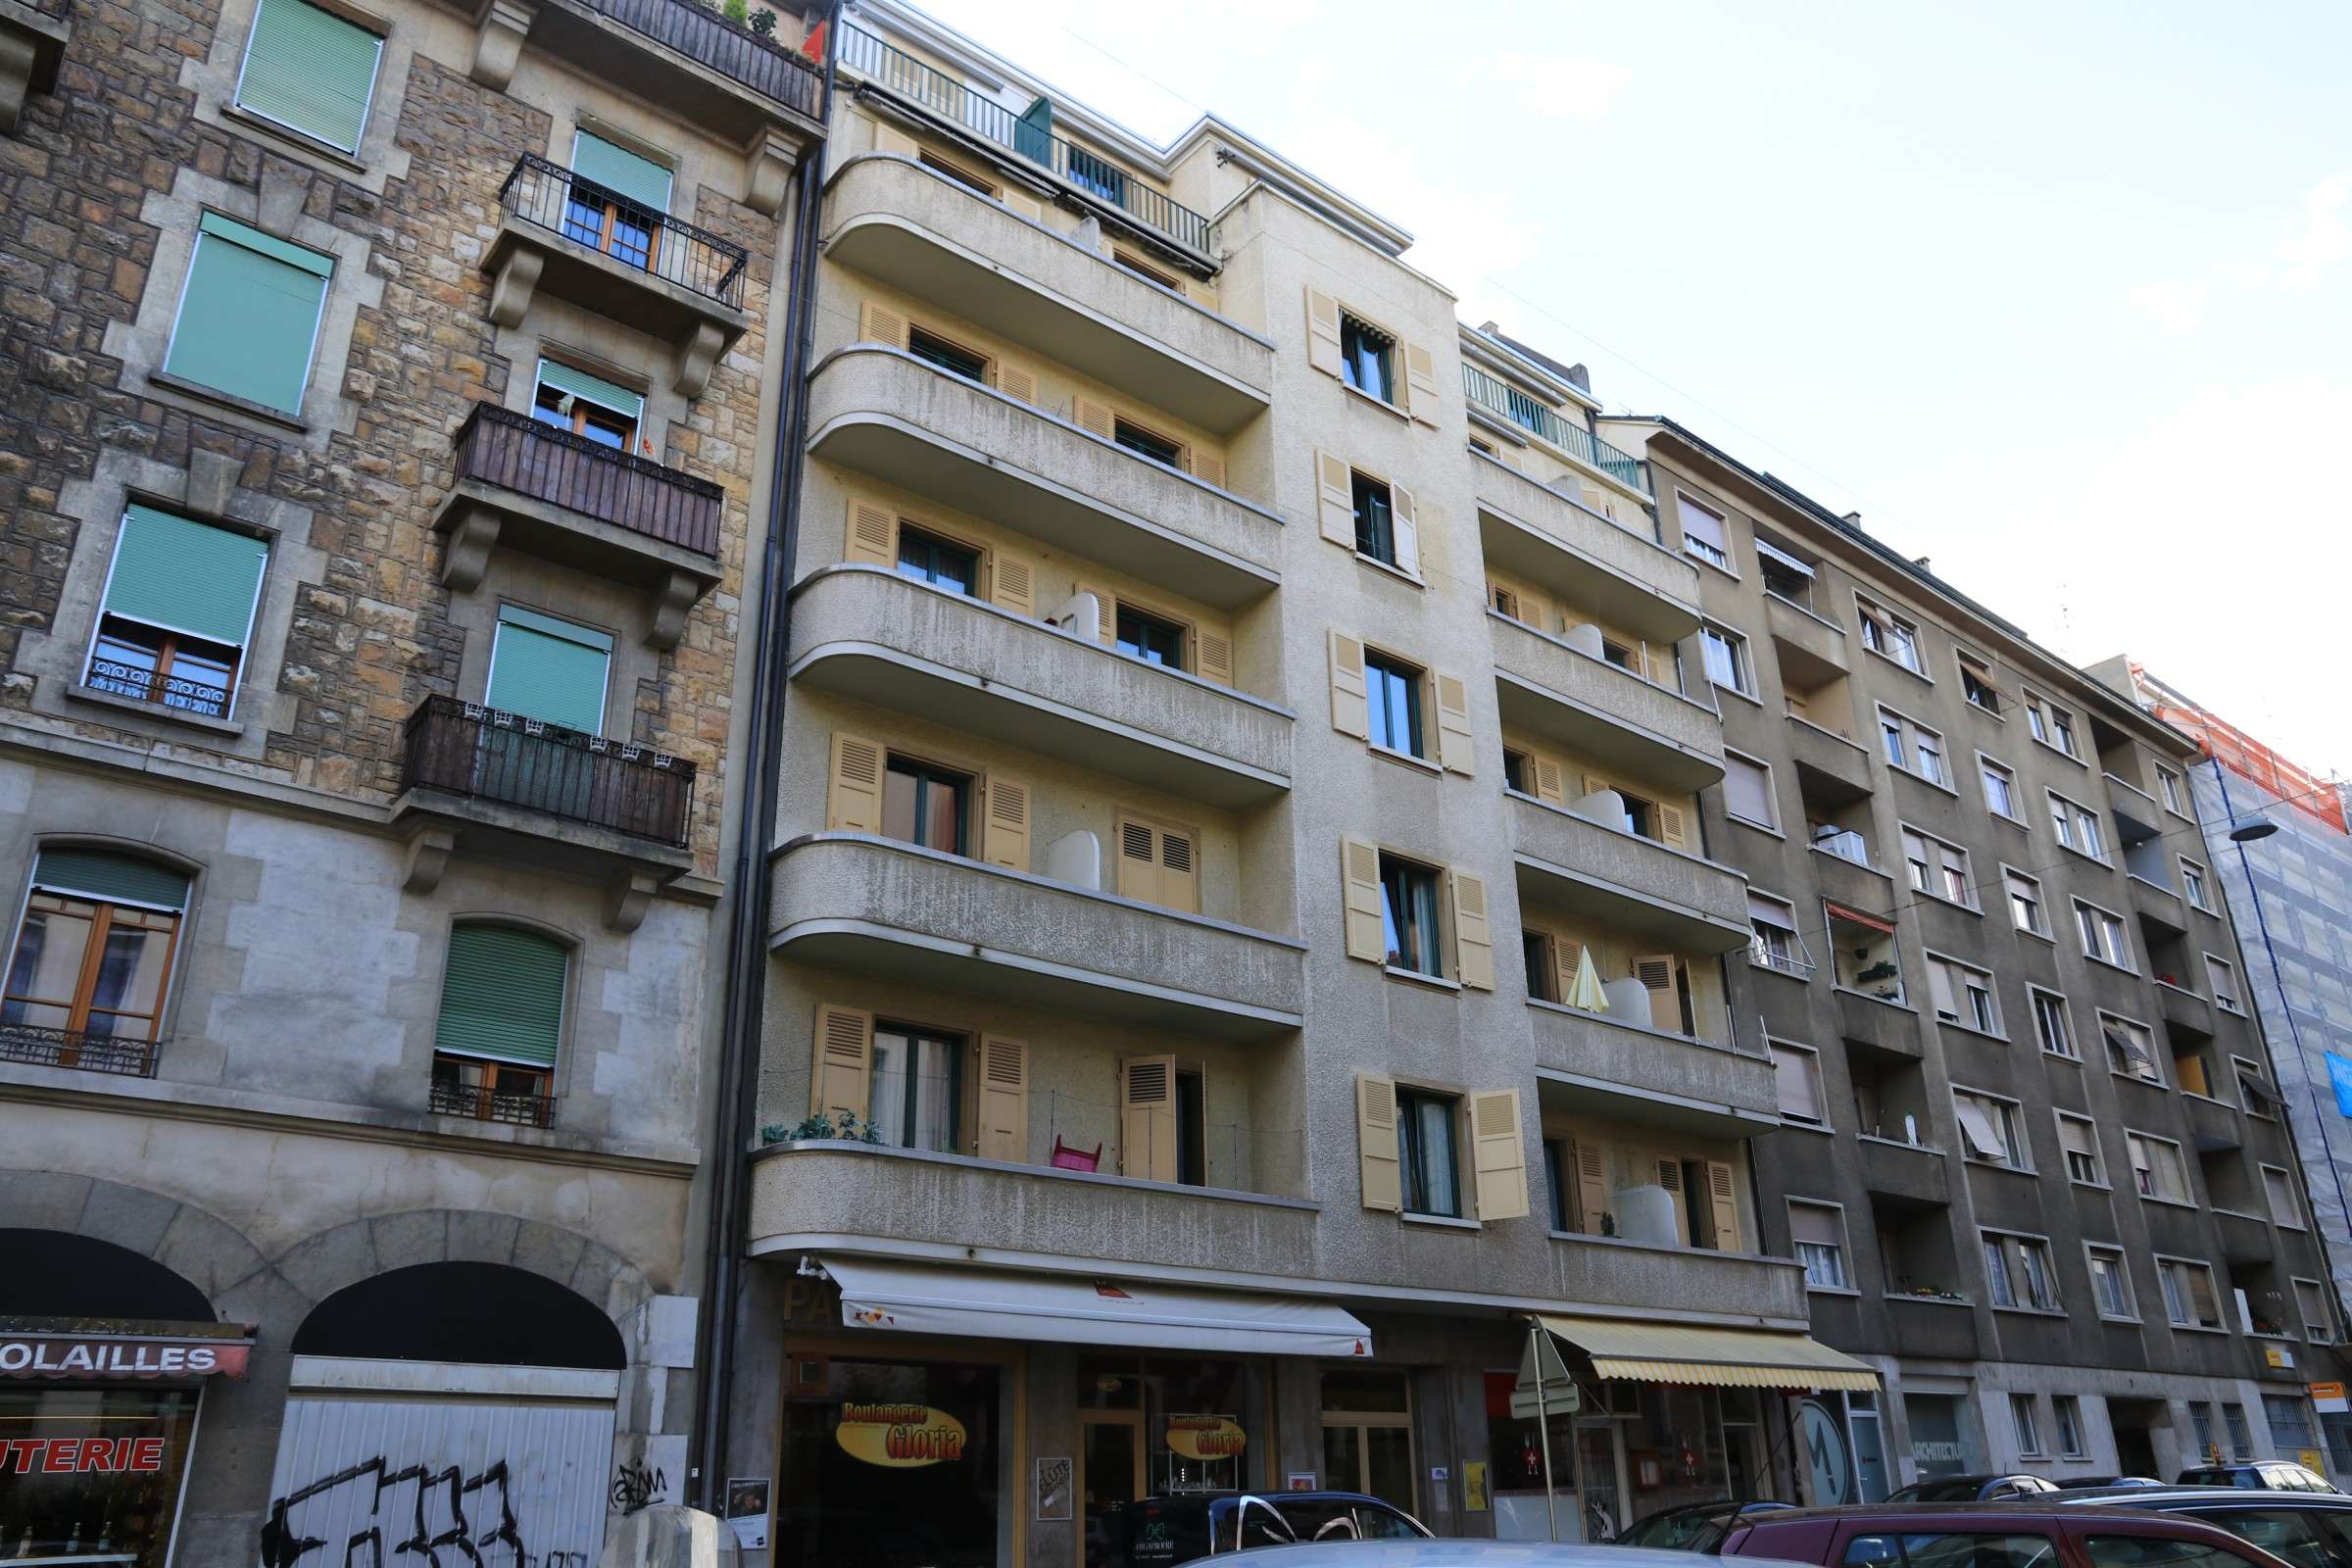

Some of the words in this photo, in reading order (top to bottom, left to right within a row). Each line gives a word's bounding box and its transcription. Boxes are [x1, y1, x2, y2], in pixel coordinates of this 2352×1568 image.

[0, 1344, 216, 1371] OLAILLES
[843, 1402, 928, 1424] Boulangerie
[886, 1424, 961, 1459] Gloria
[1197, 1431, 1243, 1455] Gloria
